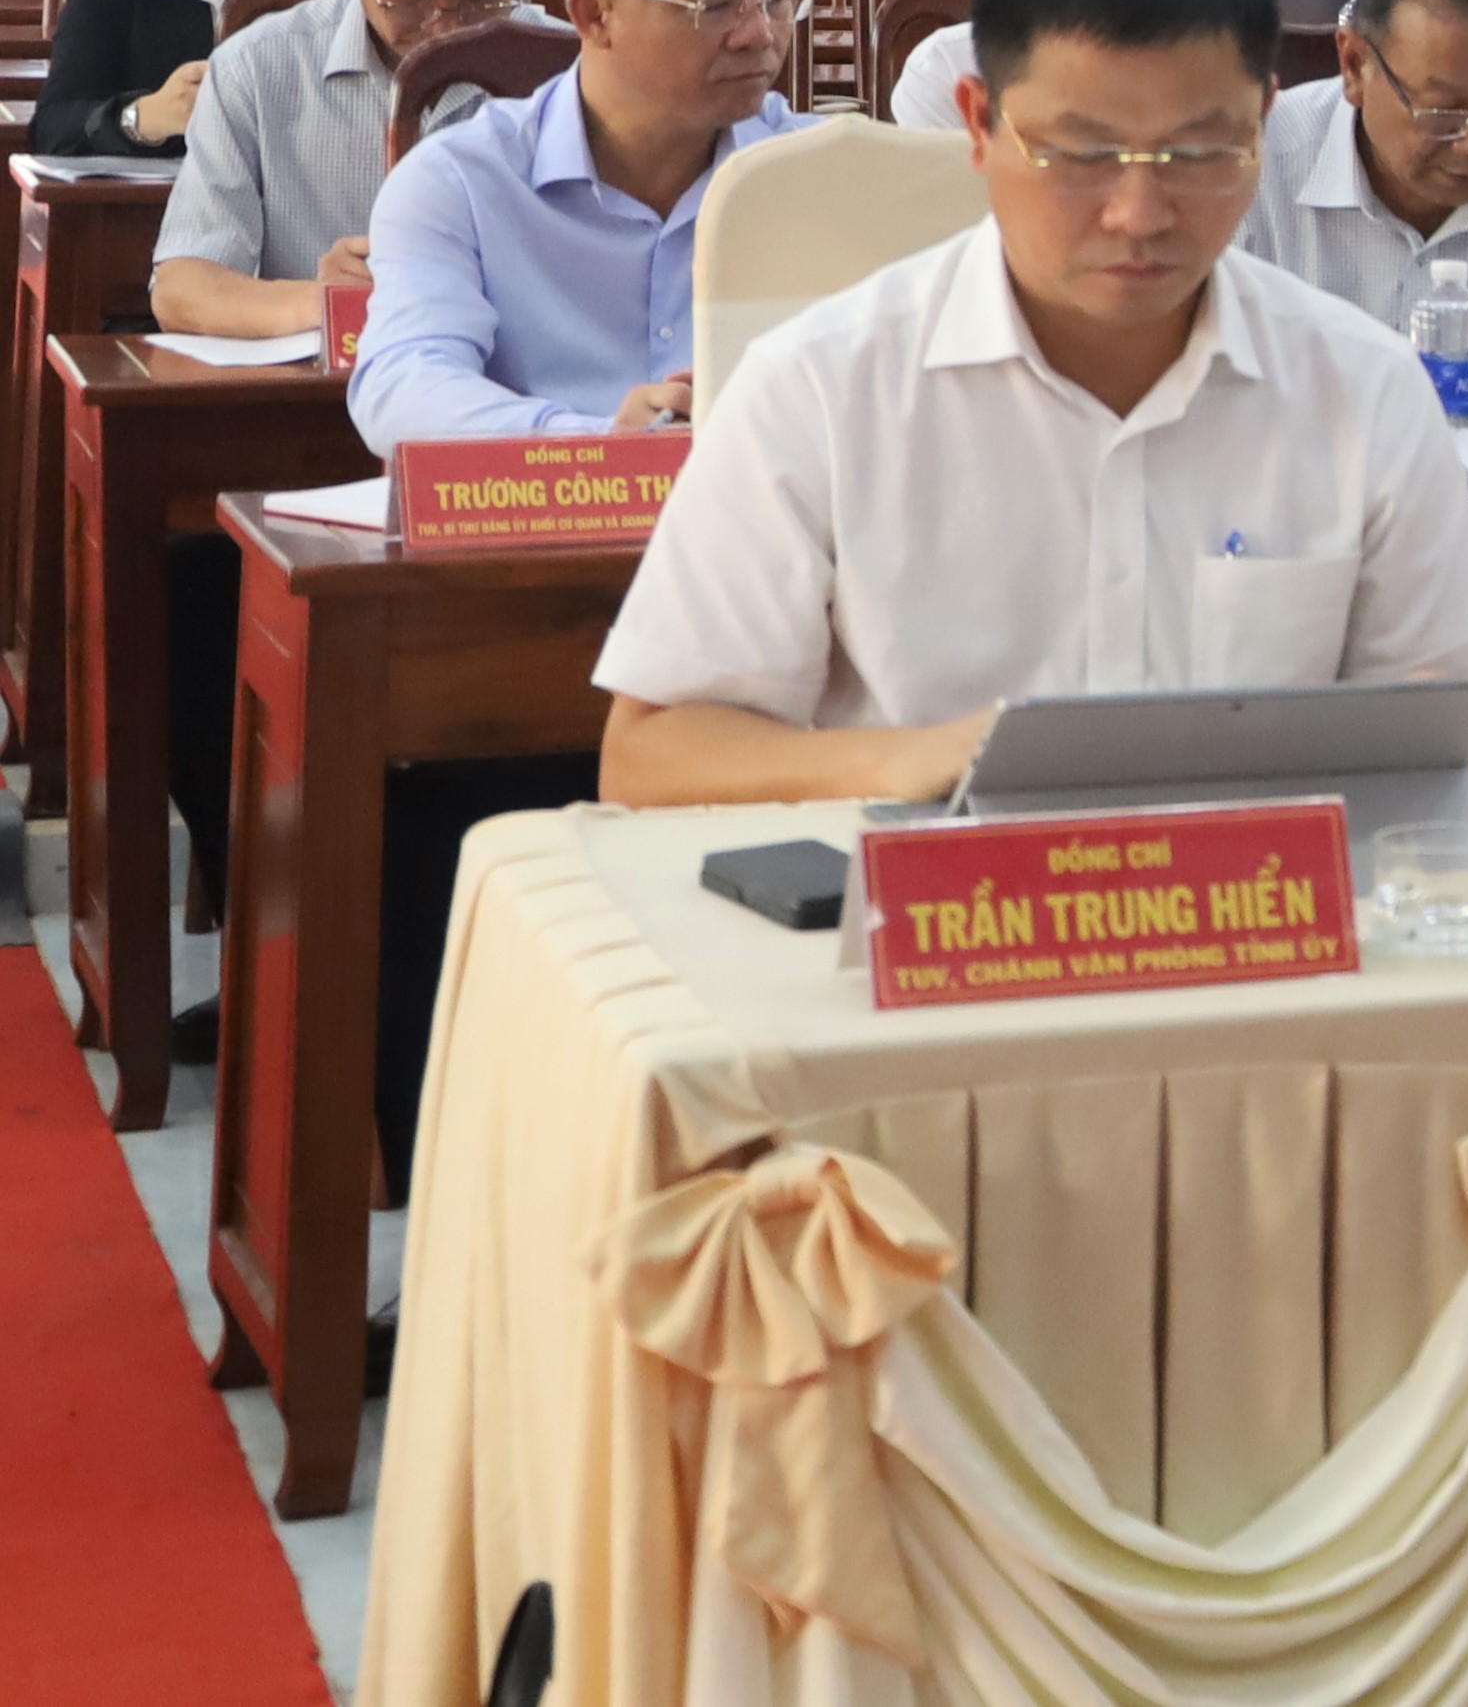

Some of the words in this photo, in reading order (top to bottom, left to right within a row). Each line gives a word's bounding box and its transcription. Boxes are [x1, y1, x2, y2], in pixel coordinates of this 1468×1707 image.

[524, 446, 572, 465] ĐỒNG
[576, 445, 605, 464] CHÍ
[433, 476, 547, 511] TRƯƠNG
[554, 471, 629, 506] CÔNG
[636, 475, 672, 502] TH
[1046, 838, 1122, 875] ĐỒNG
[1126, 835, 1173, 871] CHÍ
[904, 877, 1036, 954] TRẦN
[1044, 883, 1197, 944] TRUNG
[1208, 852, 1318, 933] HIỂN
